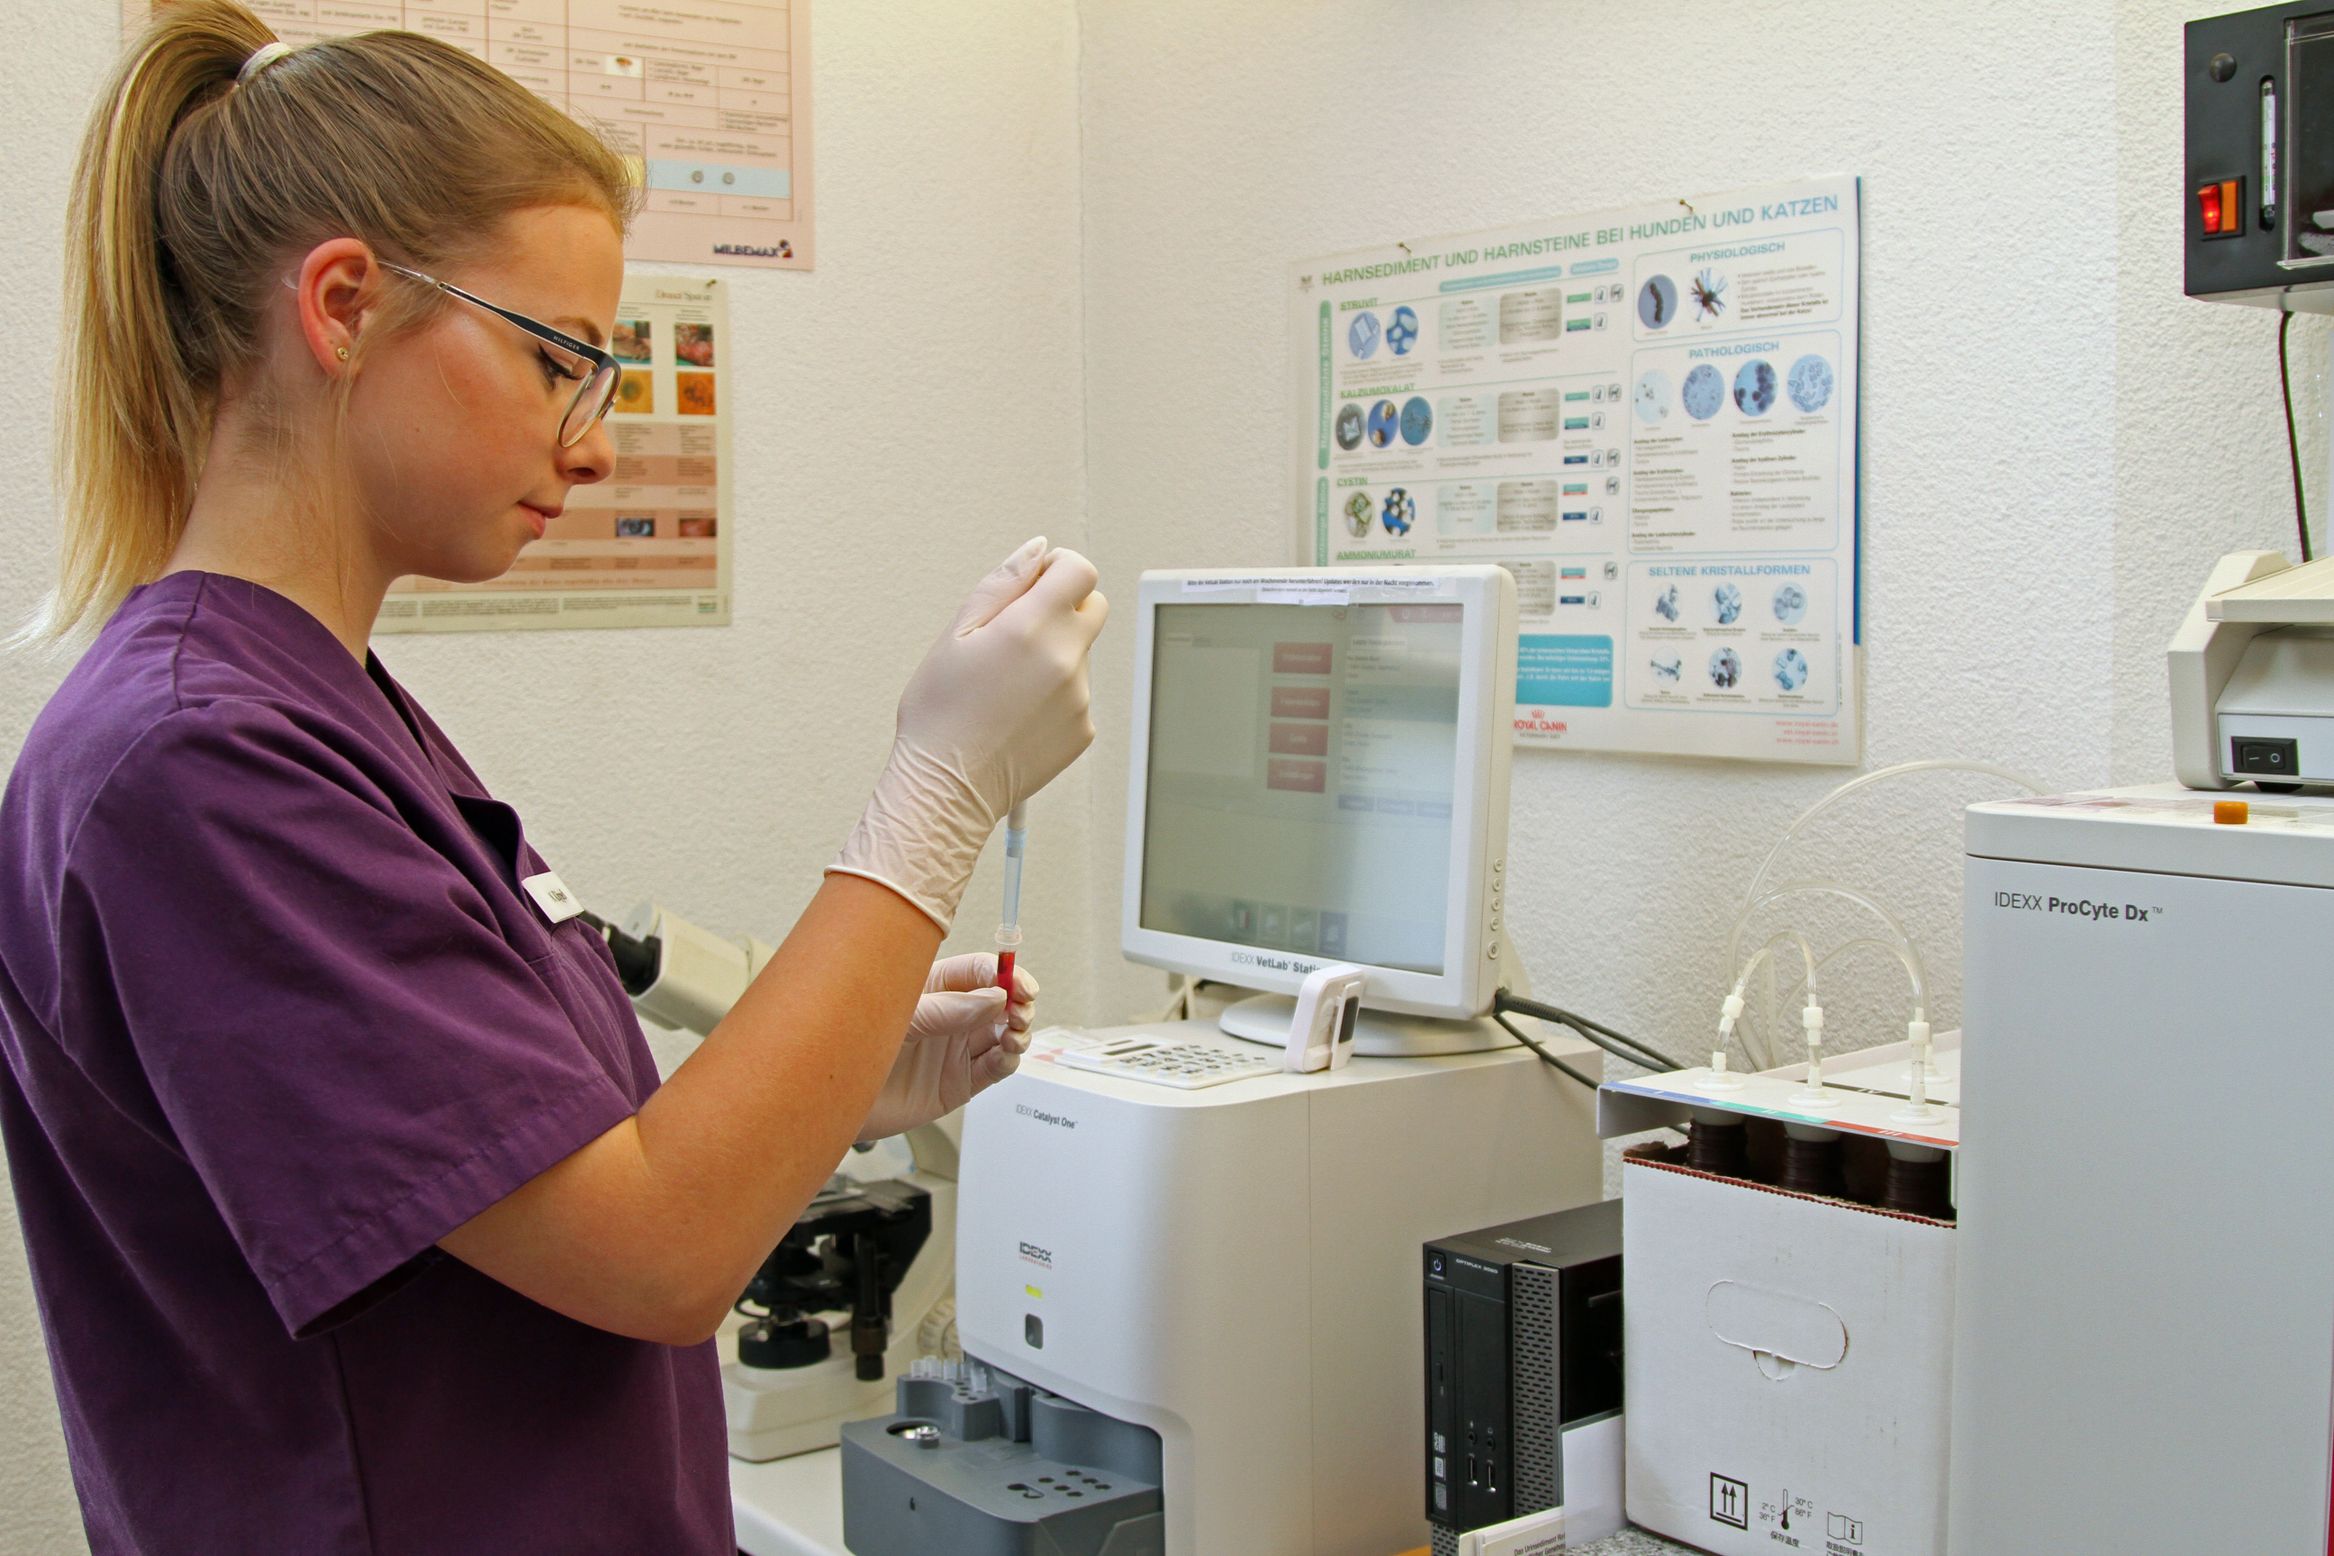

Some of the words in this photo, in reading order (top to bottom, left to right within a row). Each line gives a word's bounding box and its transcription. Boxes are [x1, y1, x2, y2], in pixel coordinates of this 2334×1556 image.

[1322, 255, 1441, 286] HARNSEDIMENT
[1445, 249, 1479, 268] UND
[1484, 231, 1591, 261] HARNSTEINE
[1597, 228, 1624, 245] BEI
[1630, 215, 1707, 240] HUNDEN
[1713, 208, 1754, 228] UND
[1762, 195, 1838, 221] KATZEN
[1690, 241, 1786, 263] PHYSIOLOGISCH
[1340, 297, 1378, 311] STRUVIT
[553, 335, 580, 351] HILFIGER
[1689, 341, 1780, 359] PATHOLOGISCH
[1337, 477, 1369, 487] CYSTIN
[1337, 548, 1416, 561] AMMONIUMURAT
[1649, 566, 1697, 577] SELTENE
[1701, 564, 1811, 576] KRISTALLFORMEN
[1540, 721, 1568, 732] CANIN
[1994, 891, 2042, 911] IDEXX
[2048, 896, 2119, 921] ProCyte
[1231, 951, 1255, 965] IDEXX
[1033, 1108, 1060, 1126] Catalyst
[1019, 1241, 1052, 1264] IDEXX
[1769, 1504, 1777, 1514] C
[1807, 1499, 1814, 1510] C
[1770, 1515, 1777, 1523] F
[1806, 1510, 1813, 1520] F
